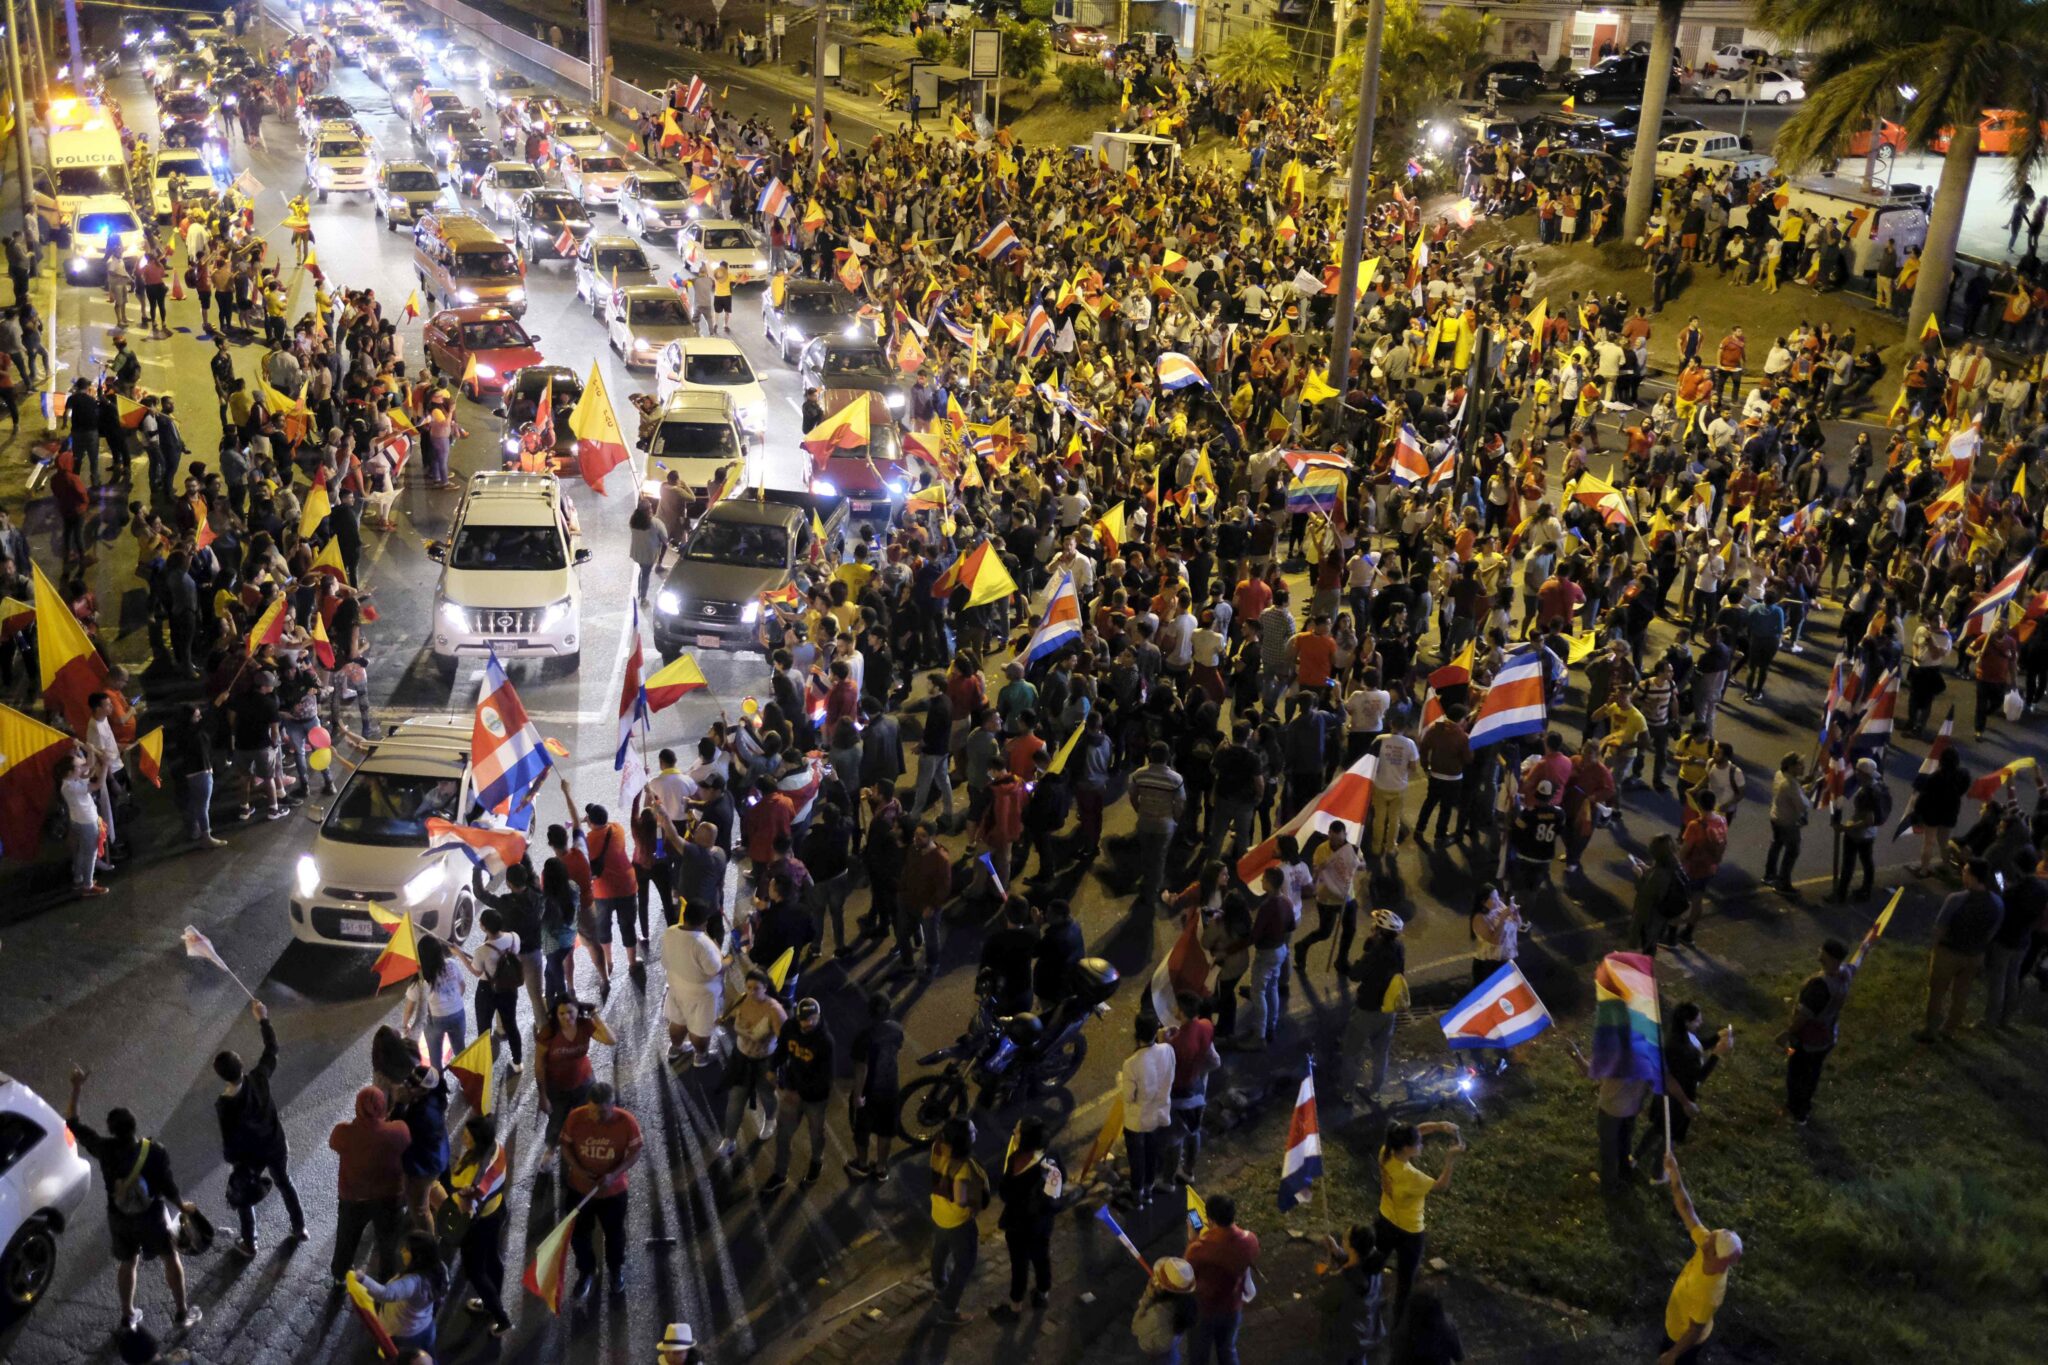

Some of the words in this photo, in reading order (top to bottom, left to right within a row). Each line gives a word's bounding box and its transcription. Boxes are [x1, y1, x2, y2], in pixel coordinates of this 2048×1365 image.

[55, 153, 117, 165] POLICIA
[1535, 823, 1556, 843] 86
[580, 1145, 615, 1160] RICA
